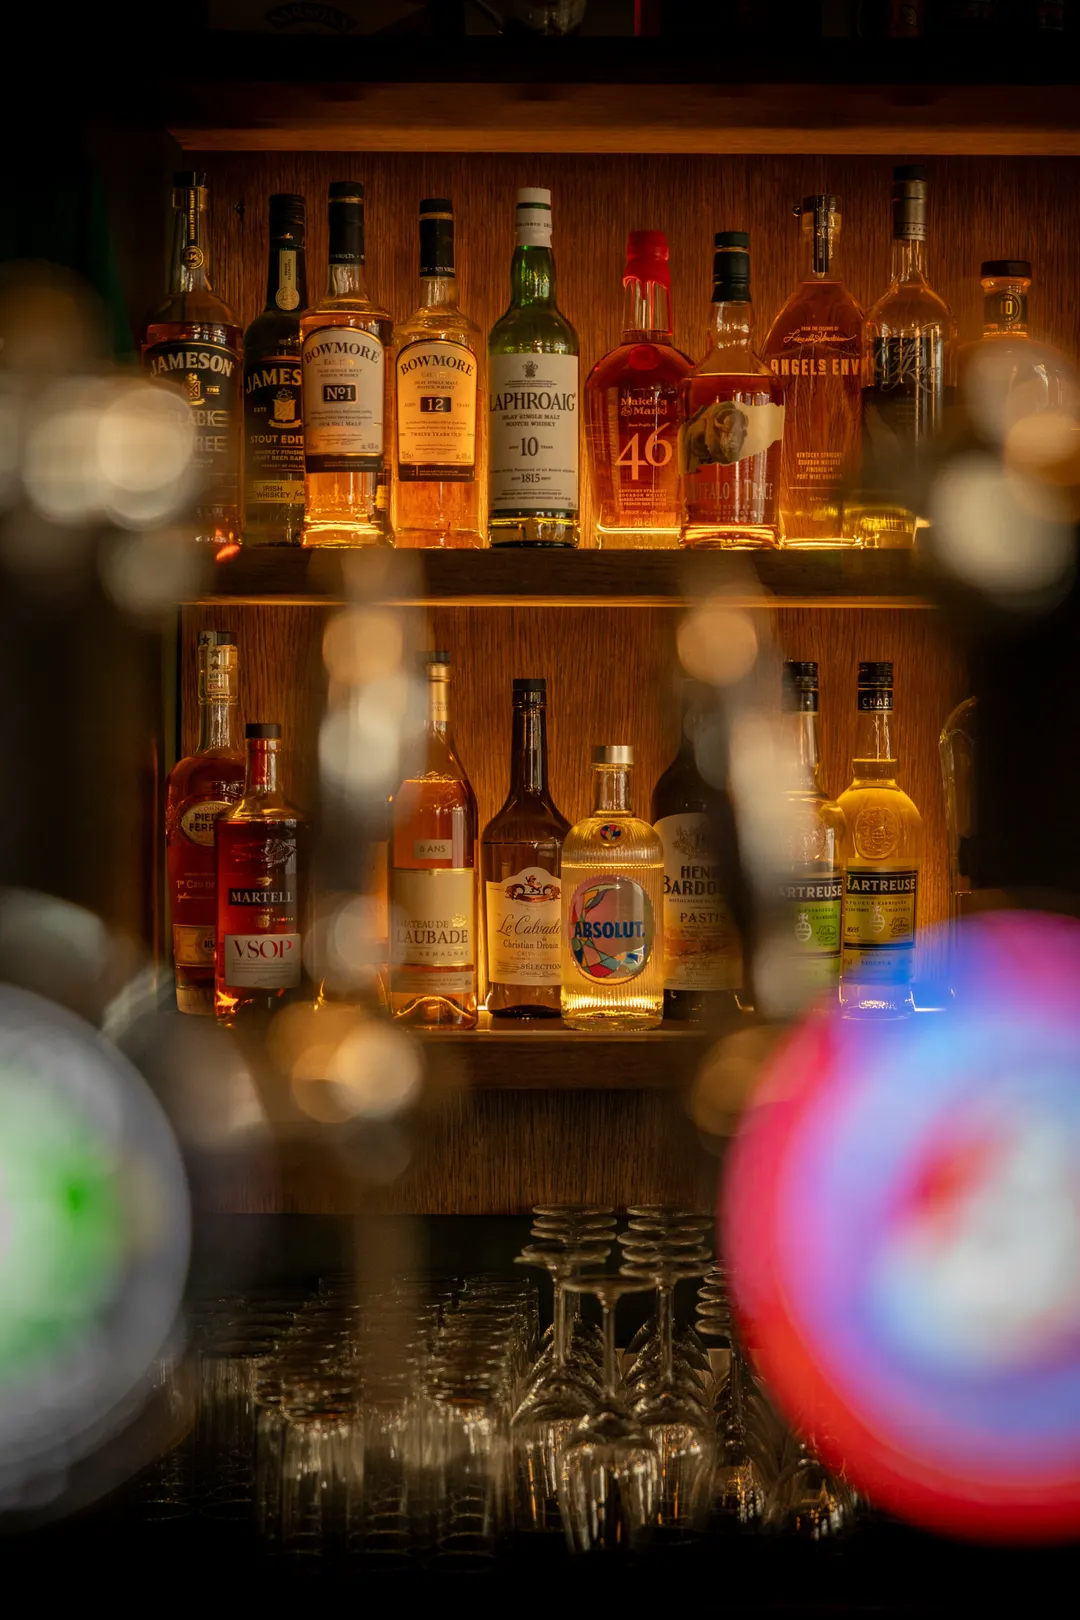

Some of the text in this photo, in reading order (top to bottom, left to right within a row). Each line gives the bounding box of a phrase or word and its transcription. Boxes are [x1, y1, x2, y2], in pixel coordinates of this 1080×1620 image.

[304, 342, 380, 364] BOWMORE
[150, 352, 234, 378] JAMESON
[400, 355, 474, 377] BOWMORE
[246, 369, 301, 394] JAMES
[428, 399, 444, 411] 12
[250, 435, 278, 444] STOUT
[521, 437, 538, 457] 10
[615, 422, 672, 480] 46
[521, 473, 541, 483] 1815
[256, 491, 291, 499] WHISKEY
[427, 845, 446, 853] ANS
[231, 891, 295, 904] MARTELL
[436, 920, 449, 928] DE
[680, 912, 727, 923] PASTIS
[574, 921, 646, 939] ABSOLUT.
[233, 939, 293, 959] VSOP
[503, 939, 534, 949] Christian
